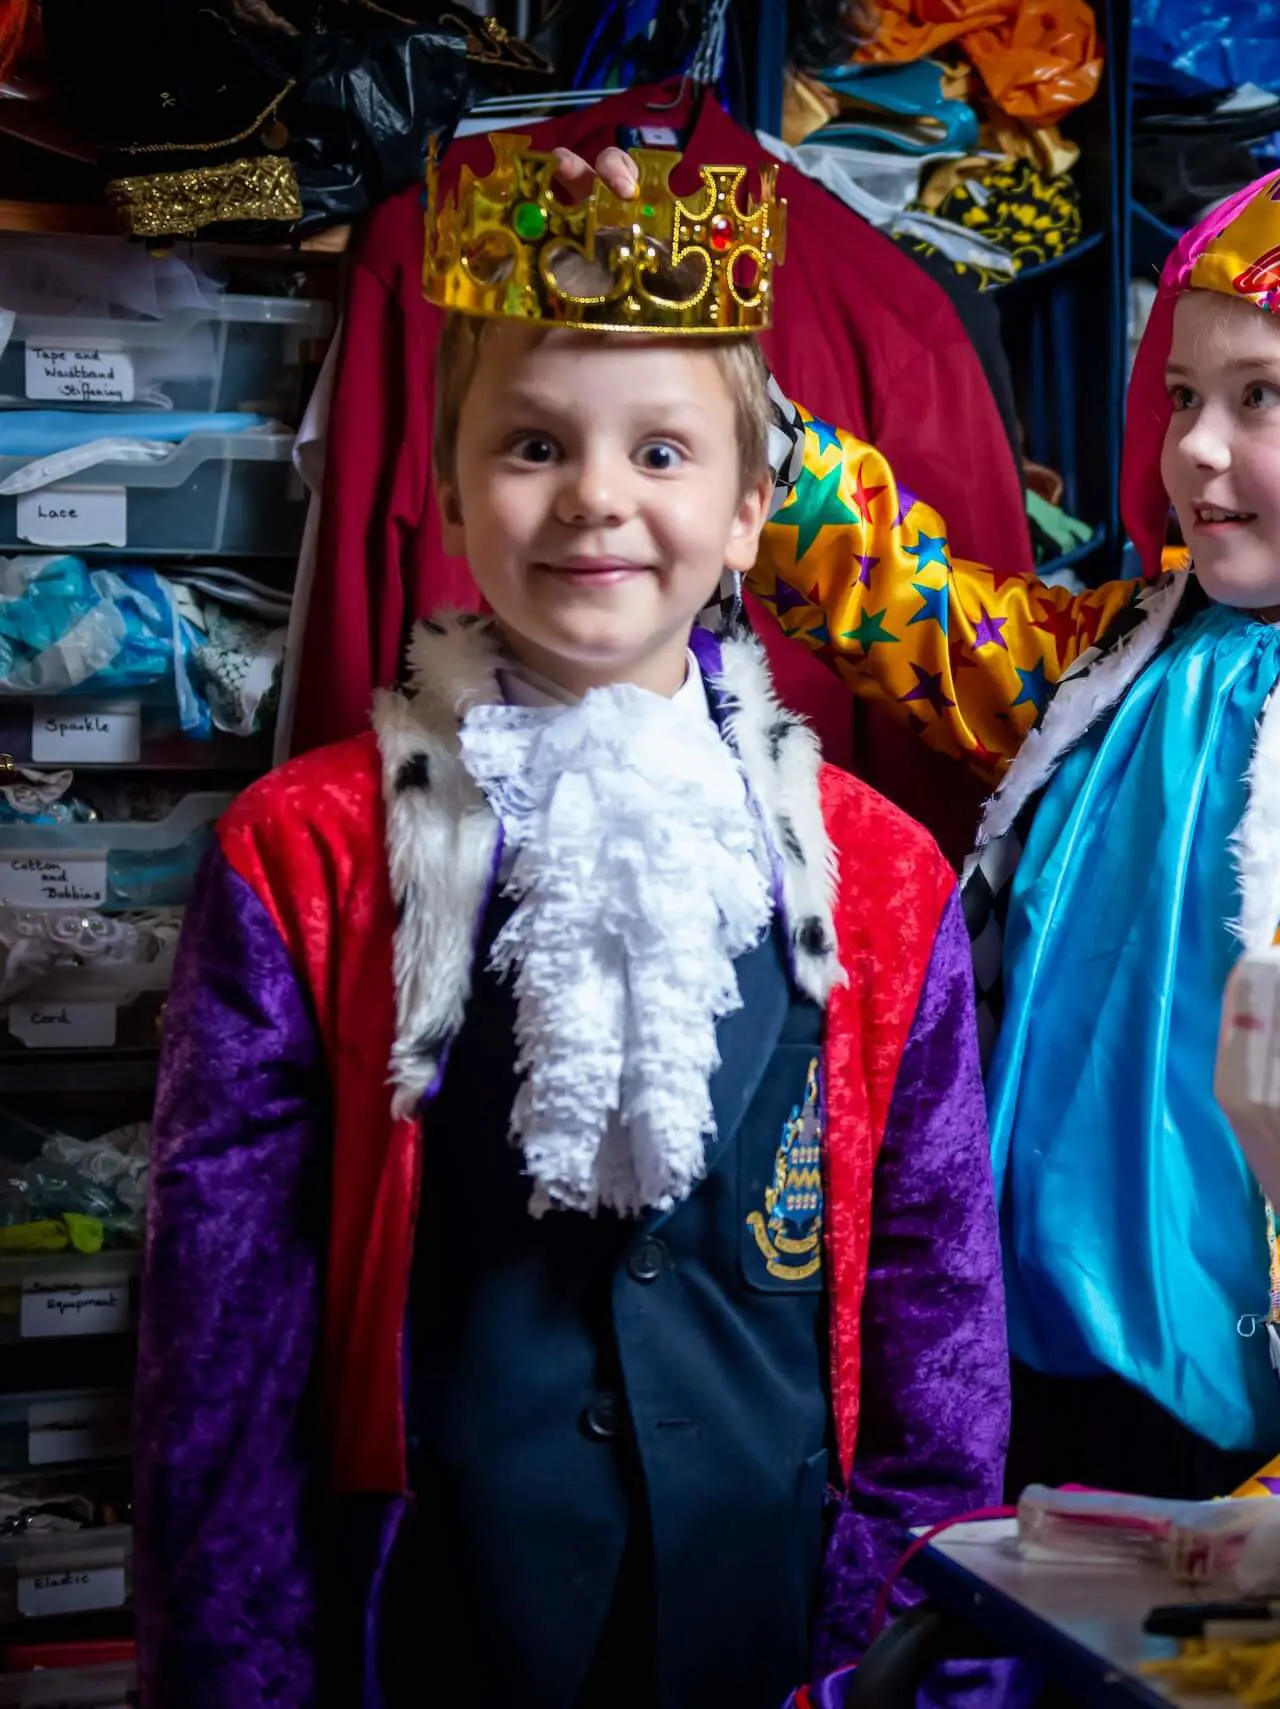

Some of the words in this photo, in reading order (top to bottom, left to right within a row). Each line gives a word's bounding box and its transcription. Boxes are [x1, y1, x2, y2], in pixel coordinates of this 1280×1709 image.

[32, 347, 66, 365] Tape
[74, 348, 101, 361] and
[44, 364, 115, 379] Waistband
[38, 504, 78, 519] Lace
[45, 716, 109, 737] Sparkle
[11, 859, 62, 871] Cotton
[41, 869, 69, 882] and
[41, 885, 102, 901] Bobbins
[30, 1006, 72, 1025] Cord
[46, 1291, 118, 1315] Equipment
[34, 1571, 90, 1590] Elastic
